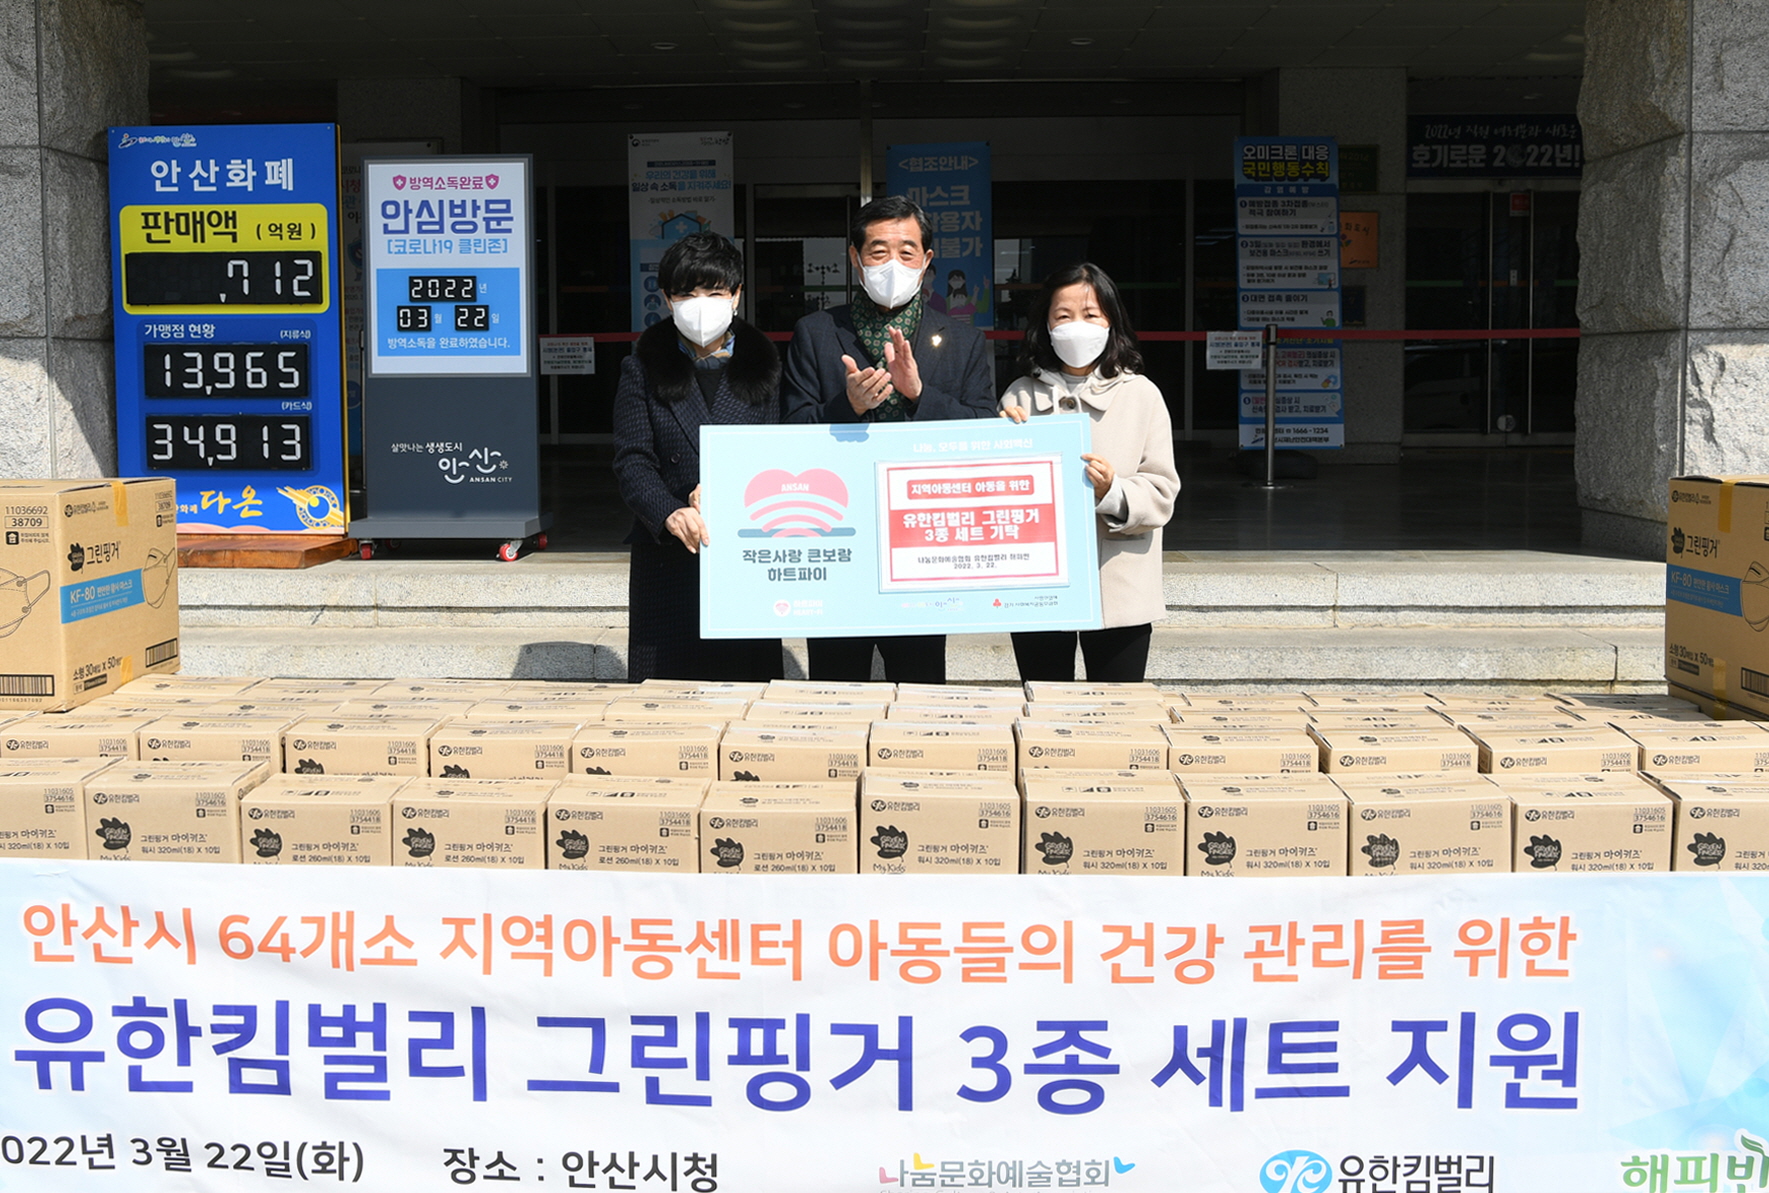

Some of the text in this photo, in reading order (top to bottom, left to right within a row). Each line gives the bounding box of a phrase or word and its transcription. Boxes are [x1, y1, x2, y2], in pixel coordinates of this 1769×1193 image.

[1425, 124, 1577, 139] 2022년 직원 여러분과 새로운
[1243, 145, 1329, 160] 오미크론 대응
[1412, 143, 1487, 168] 호기로운
[898, 155, 979, 173] <협조안내>
[1243, 161, 1329, 177] 국민행동수칙
[151, 158, 294, 192] 안산화폐
[646, 169, 716, 180] 우리의 건강을 위해
[409, 176, 484, 190] 방역소독완료
[631, 180, 732, 192] 일상 속 소독을 지켜주세요!
[907, 185, 971, 207] 마스크
[381, 199, 514, 235] 안심방문
[141, 210, 238, 244] 판매액
[387, 238, 508, 254] [코로나19 클린존]
[411, 279, 473, 298] 2022
[399, 308, 428, 328] 03
[457, 308, 486, 327] 22
[144, 324, 311, 339] 가맹점 현황 (지류식)
[388, 338, 511, 349] 방역소독을 완료하였습니다.
[164, 352, 300, 395] 13,965
[281, 401, 312, 410] (카드식)
[152, 424, 301, 467] 34,913
[391, 442, 463, 454] 살맛나는 생생도시
[938, 441, 968, 452] 모두를
[438, 447, 502, 484] 안산
[781, 483, 809, 492] ANSAN
[911, 480, 1030, 495] 지역아동센터 아동을 위한
[200, 485, 263, 518] 다온
[5, 506, 48, 515] 11036692
[12, 518, 42, 527] 38709
[903, 508, 1040, 529] 유한킴벌리 그린핑거
[925, 525, 1020, 543] 3종 세트 기탁
[86, 540, 120, 565] 그린핑거
[1686, 535, 1718, 559] 그린핑거
[742, 548, 852, 564] 작은사랑 큰보람
[918, 555, 971, 564] 나눔문화예술협회
[767, 567, 827, 582] 하트파이
[1671, 571, 1692, 587] KF-80
[70, 586, 96, 604] KF-80
[73, 667, 85, 681] 소형
[453, 746, 482, 755] 유한킴벌리
[1044, 748, 1075, 757] 유한킴벌리
[1516, 757, 1547, 766] 유한킴벌리
[108, 794, 140, 803] 유한킴벌리
[887, 801, 920, 811] 유한킴벌리
[571, 811, 603, 820] 유한킴벌리
[140, 832, 207, 843] 그린핑거 마이키즈
[158, 847, 194, 855] 320ml(18)
[205, 846, 220, 854] 10입
[1571, 850, 1642, 860] 그린핑거 마이키즈
[599, 857, 653, 866] 로션 260ml(18)
[1571, 862, 1627, 871] 워시 320ml(18)
[22, 902, 1577, 985] 안산시 64개소 지역아동센터 아동들의 건강 관리를 위한
[14, 995, 1580, 1116] 유한킴벌리 그린핑거 3종 세트 지원
[129, 1136, 192, 1173] 3월
[203, 1140, 365, 1183] 22일(화)
[443, 1146, 521, 1185] 장소
[537, 1157, 544, 1181] :
[561, 1150, 719, 1193] 안산시청
[879, 1152, 1110, 1188] 나눔문화예술협회
[1338, 1155, 1495, 1193] 유한킴벌리
